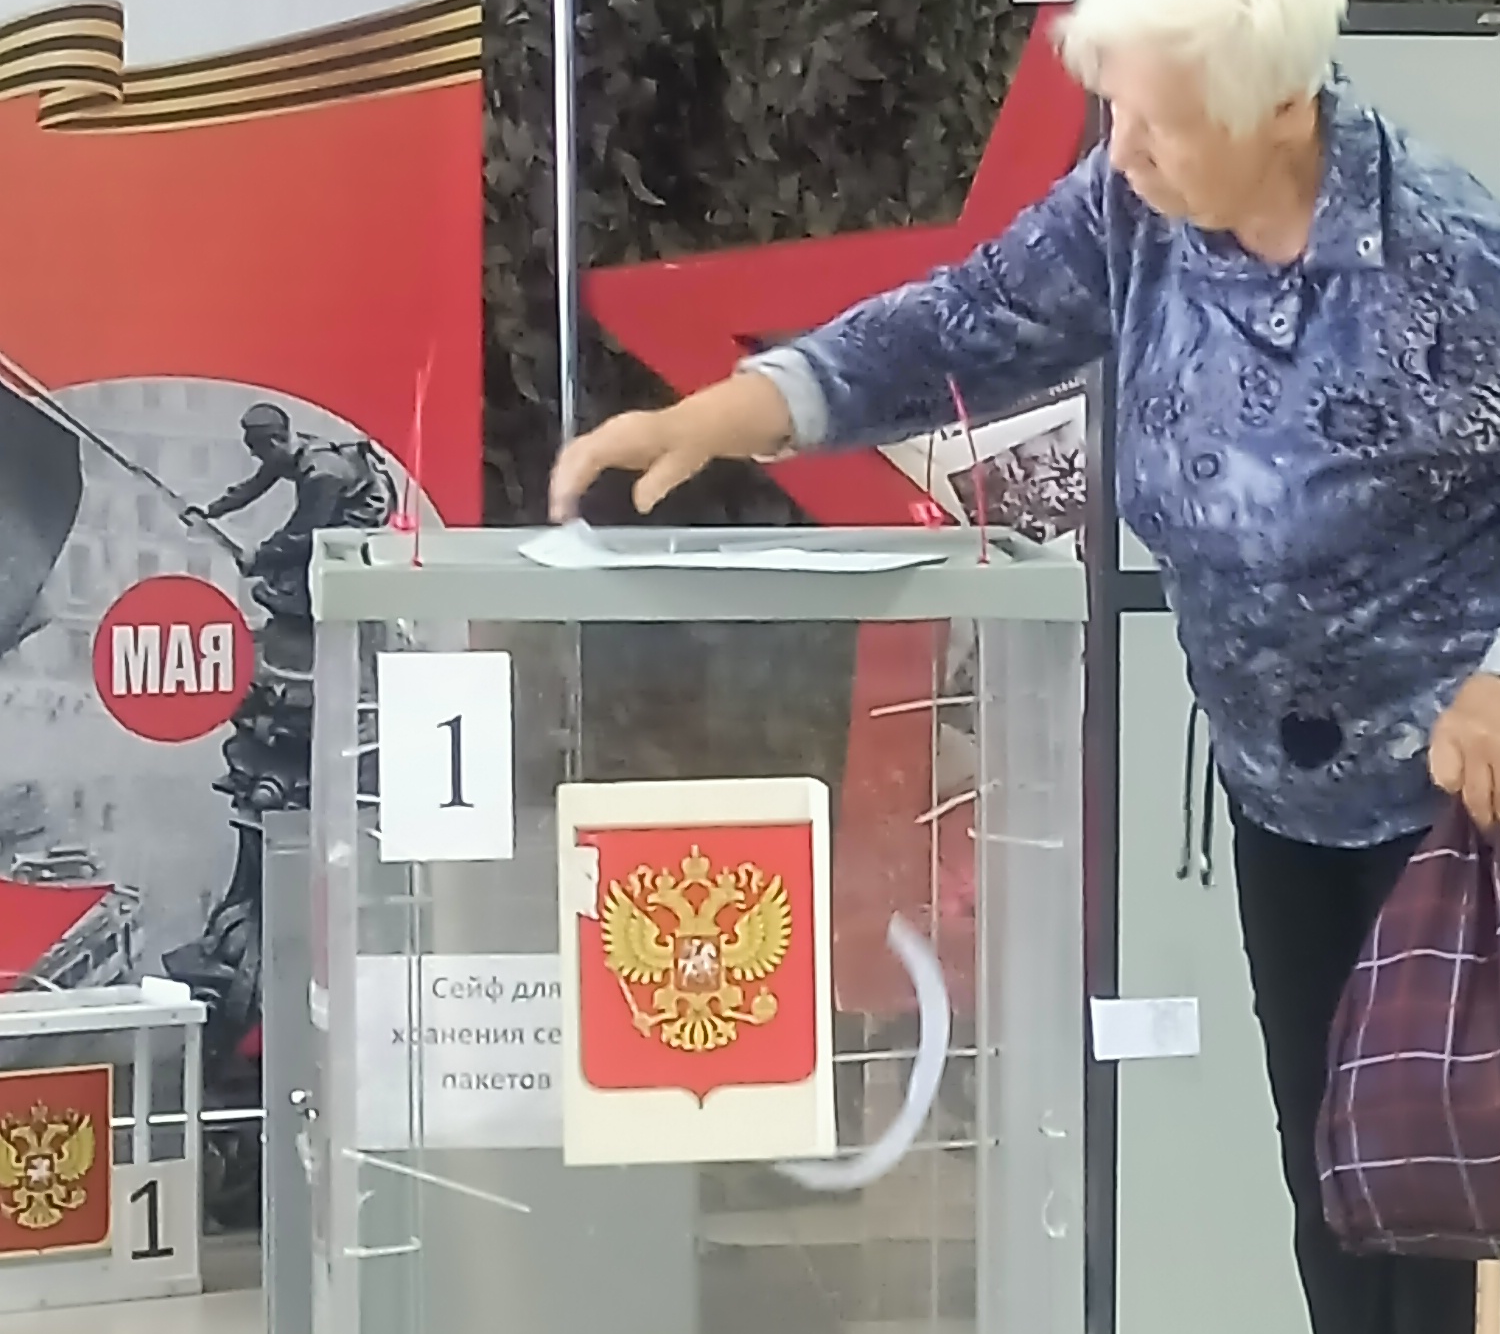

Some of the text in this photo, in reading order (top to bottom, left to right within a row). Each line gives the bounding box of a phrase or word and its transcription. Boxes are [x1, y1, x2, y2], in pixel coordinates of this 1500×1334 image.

[111, 622, 234, 696] МАЯ
[436, 714, 475, 809] 1
[432, 975, 562, 1003] Сейф для
[442, 1071, 552, 1091] пакетов
[130, 1179, 174, 1260] 1
